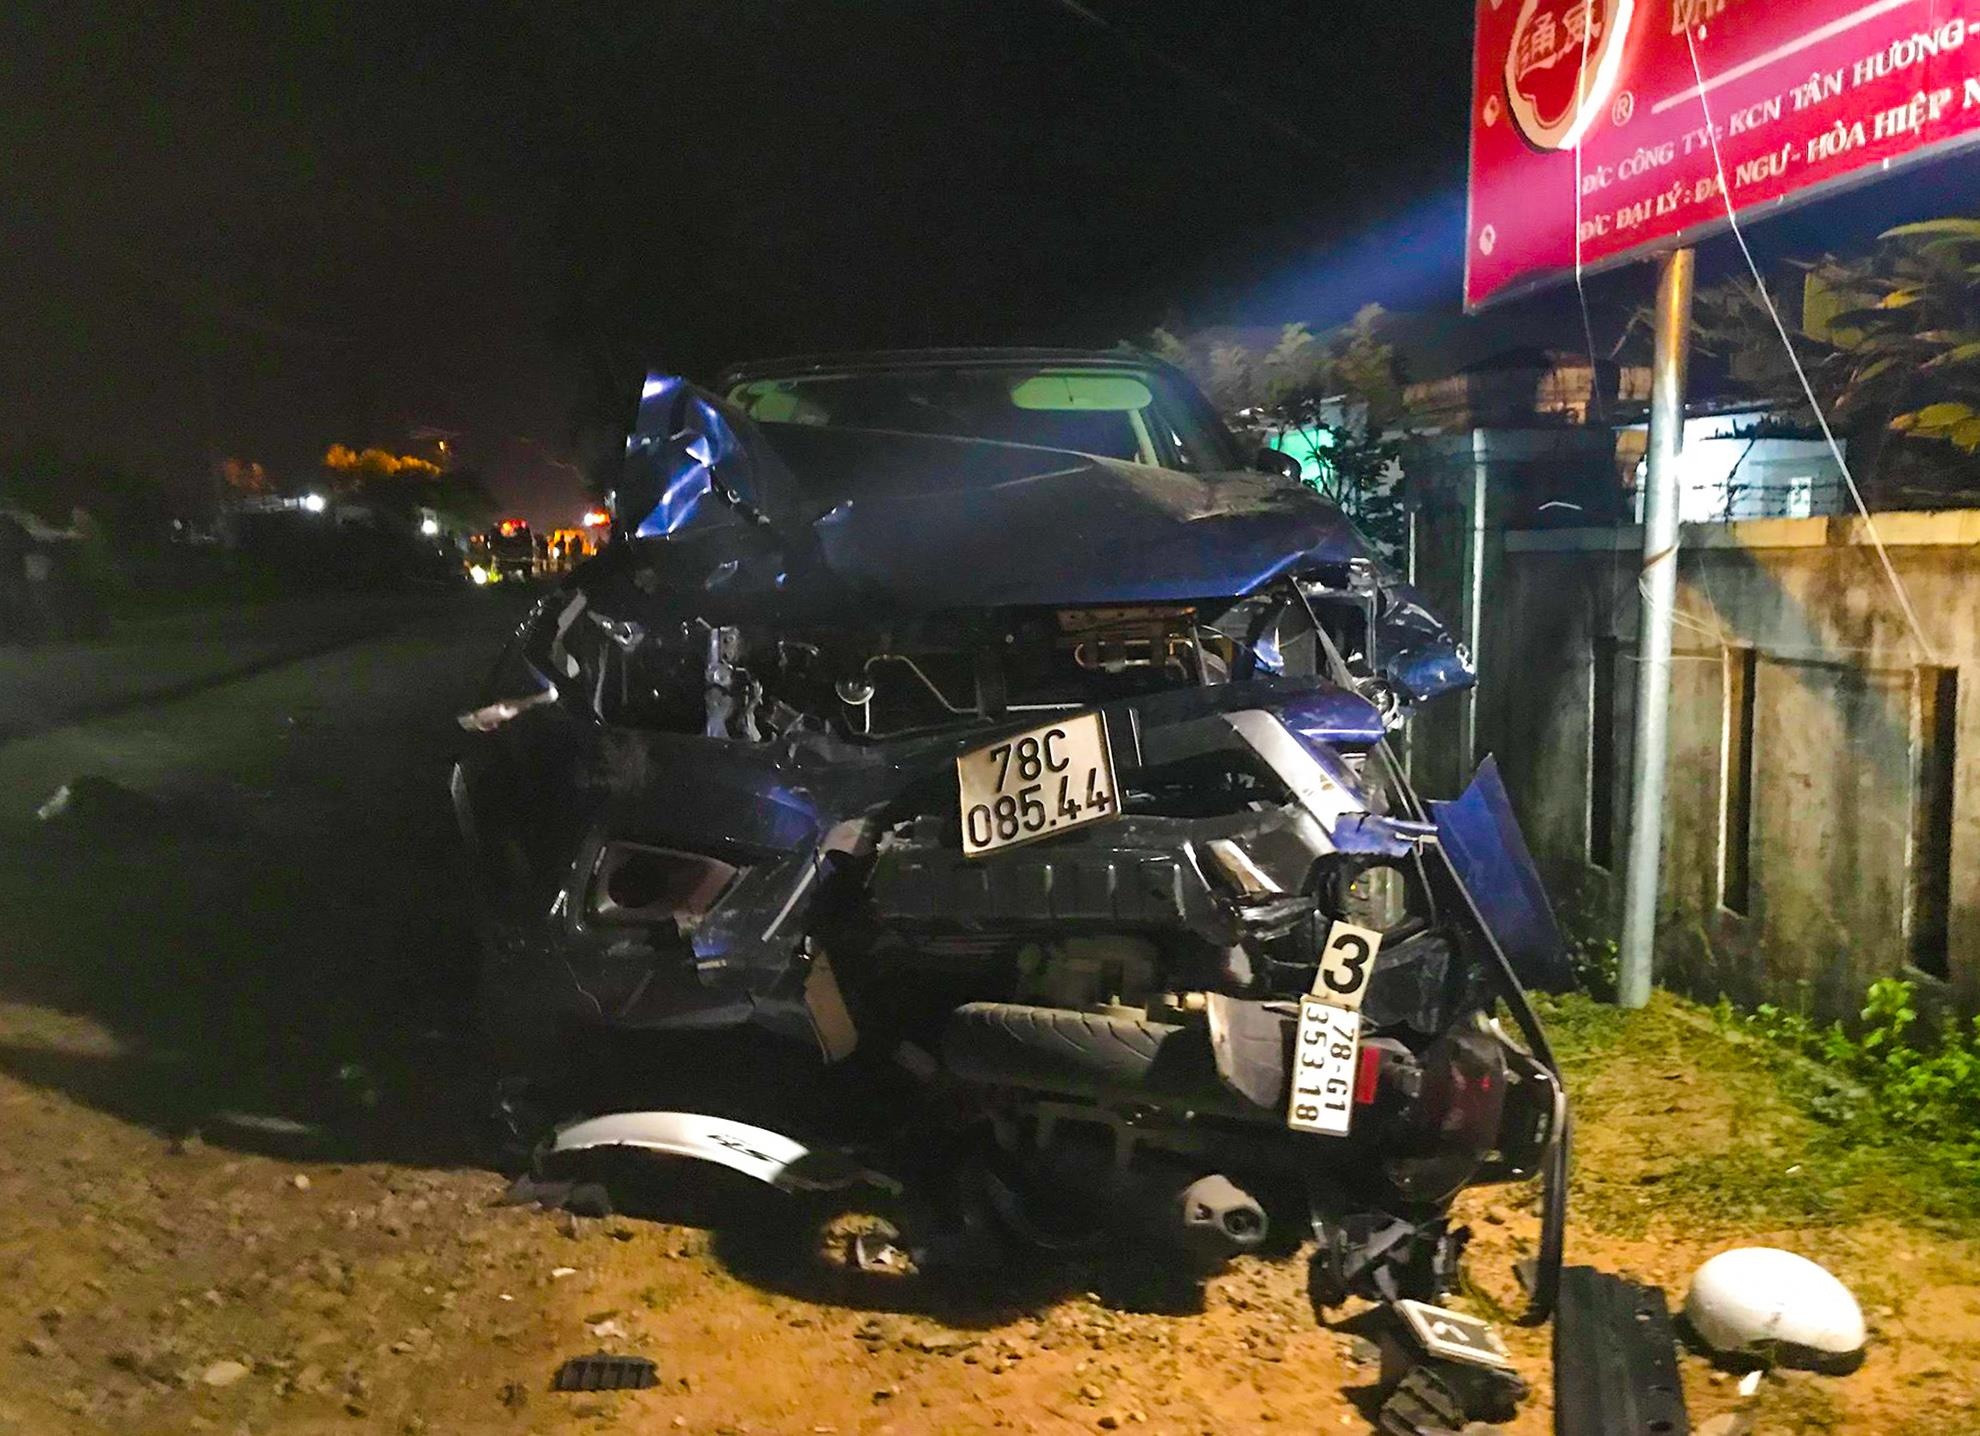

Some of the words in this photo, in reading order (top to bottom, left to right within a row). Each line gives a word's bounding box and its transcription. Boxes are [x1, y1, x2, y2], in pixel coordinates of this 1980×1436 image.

[1616, 199, 1652, 229] ĐẠI
[1807, 119, 1866, 164] HÒA
[1873, 88, 1952, 136] HIỆP
[1618, 148, 1674, 181] CÔNG
[1729, 95, 1781, 136] KCN
[1790, 69, 1844, 111] TÂN
[989, 729, 1070, 793] 78C
[968, 767, 1111, 847] 085.44
[1323, 933, 1370, 994] 3
[1295, 1006, 1329, 1122] 353.18
[1325, 1025, 1356, 1112] 78-G1
